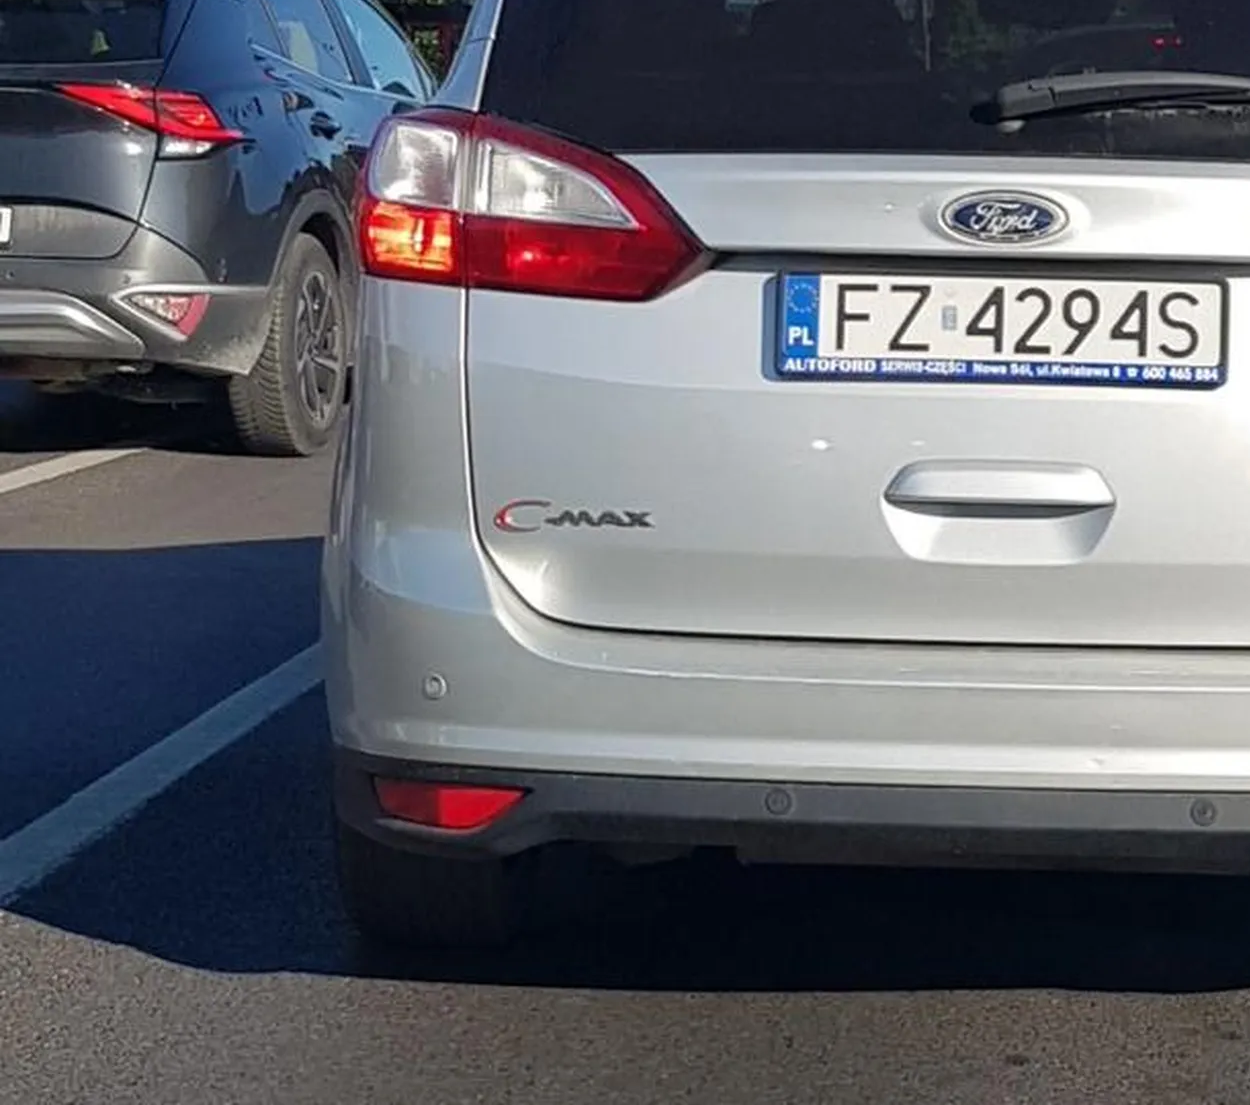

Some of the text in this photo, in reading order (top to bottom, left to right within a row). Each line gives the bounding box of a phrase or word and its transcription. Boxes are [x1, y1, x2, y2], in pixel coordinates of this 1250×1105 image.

[970, 201, 1039, 232] Ford
[835, 283, 1199, 359] FZ 4294S
[788, 326, 814, 346] PL
[784, 358, 876, 373] AUTOFORD
